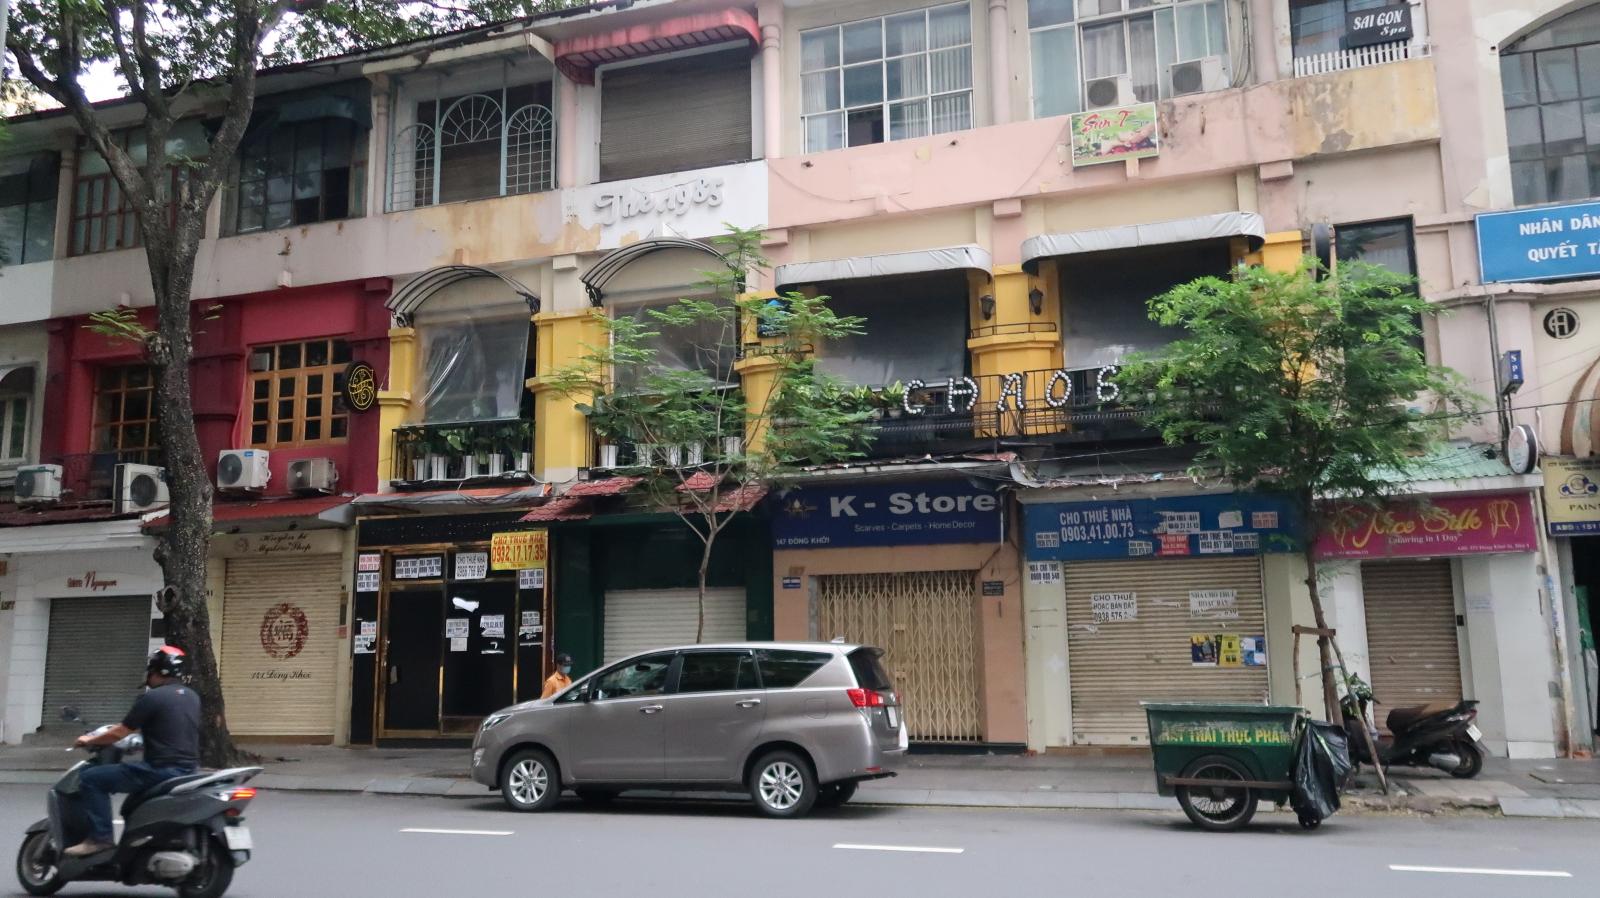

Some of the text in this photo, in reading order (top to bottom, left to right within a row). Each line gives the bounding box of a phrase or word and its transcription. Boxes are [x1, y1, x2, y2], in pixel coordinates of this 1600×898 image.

[1353, 9, 1404, 31] SAI GON
[1380, 26, 1407, 36] Spa
[1519, 217, 1563, 235] NHÂN
[1527, 240, 1579, 262] QUYẾT
[829, 495, 858, 518] K
[888, 491, 997, 516] Store
[1060, 504, 1133, 526] CHO THUÊ NHÀ
[854, 523, 885, 533] Scarves
[891, 522, 922, 532] Carpets
[1420, 506, 1482, 533] Silk
[1060, 522, 1135, 542] 0903.41.00.73
